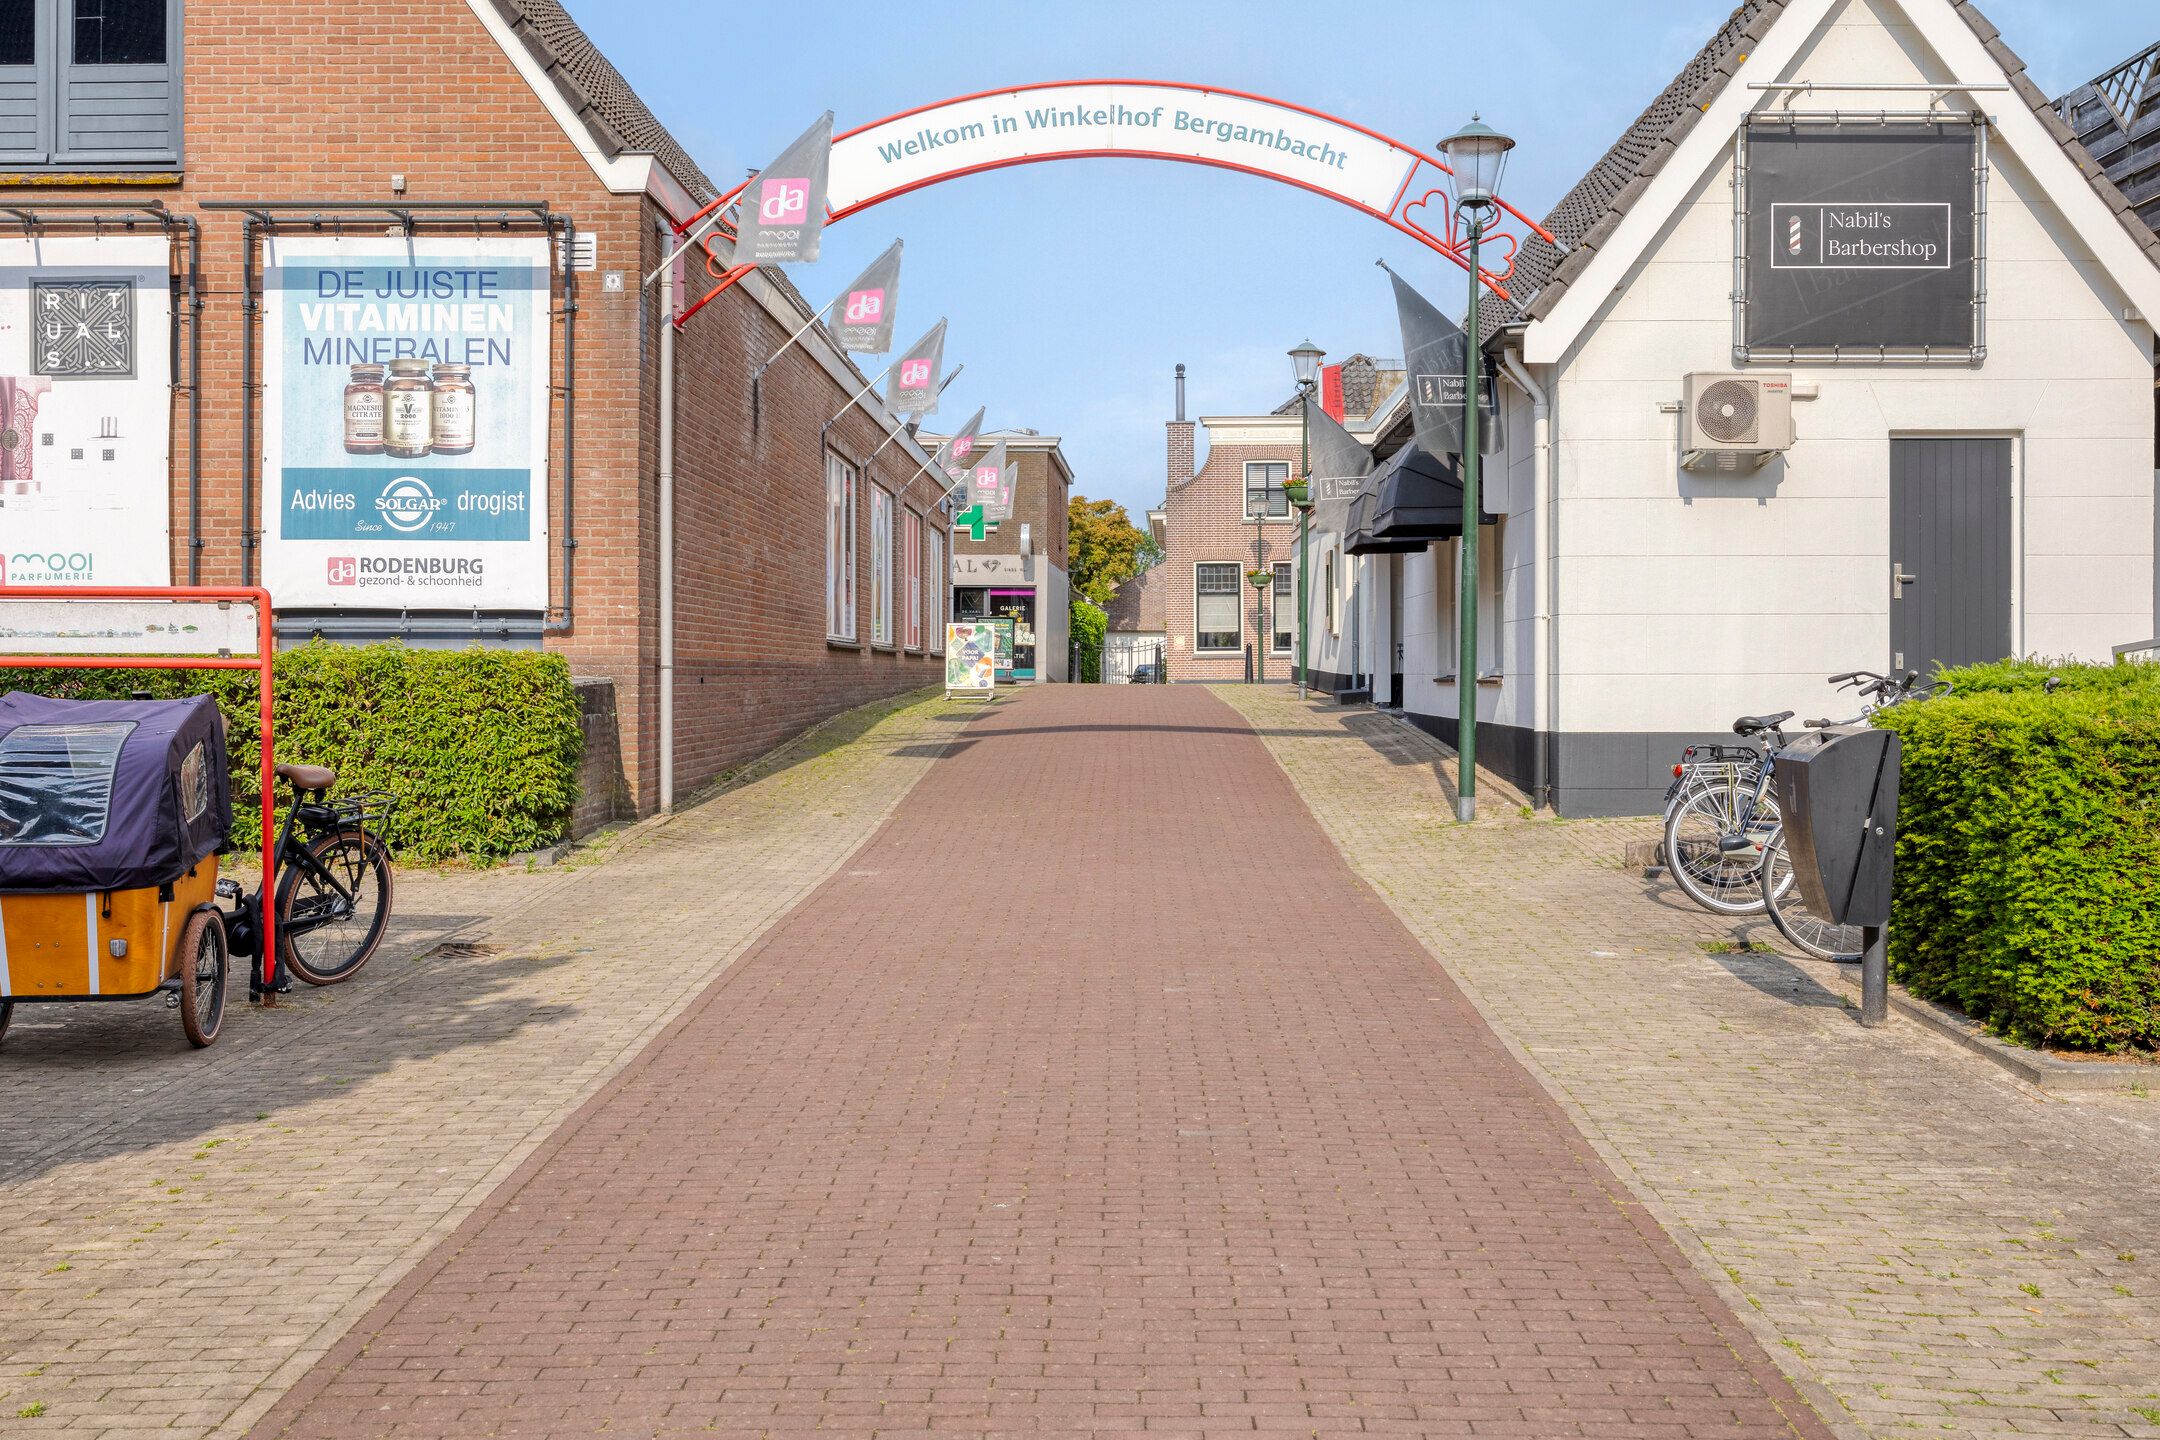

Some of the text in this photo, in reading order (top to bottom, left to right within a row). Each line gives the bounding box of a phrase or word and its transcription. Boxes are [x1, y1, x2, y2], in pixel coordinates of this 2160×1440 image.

[878, 104, 1348, 170] Welkom in Winkelhof Bergambacht
[762, 184, 804, 219] da
[1828, 211, 1892, 229] Nabil's
[1828, 239, 1937, 261] Barbershop
[318, 270, 498, 299] DE JUISTE
[299, 303, 513, 332] VITAMINEN
[847, 294, 881, 320] da
[304, 337, 511, 366] MINERALEN
[978, 470, 996, 486] da
[290, 489, 356, 510] Advies
[457, 489, 525, 515] drogist
[354, 520, 456, 533] Since 1947
[11, 552, 93, 571] mooi
[329, 560, 355, 582] da
[360, 557, 483, 574] RODENBURG
[11, 572, 93, 581] PARFUMERIE
[358, 575, 482, 588] gezond- & schoonheid
